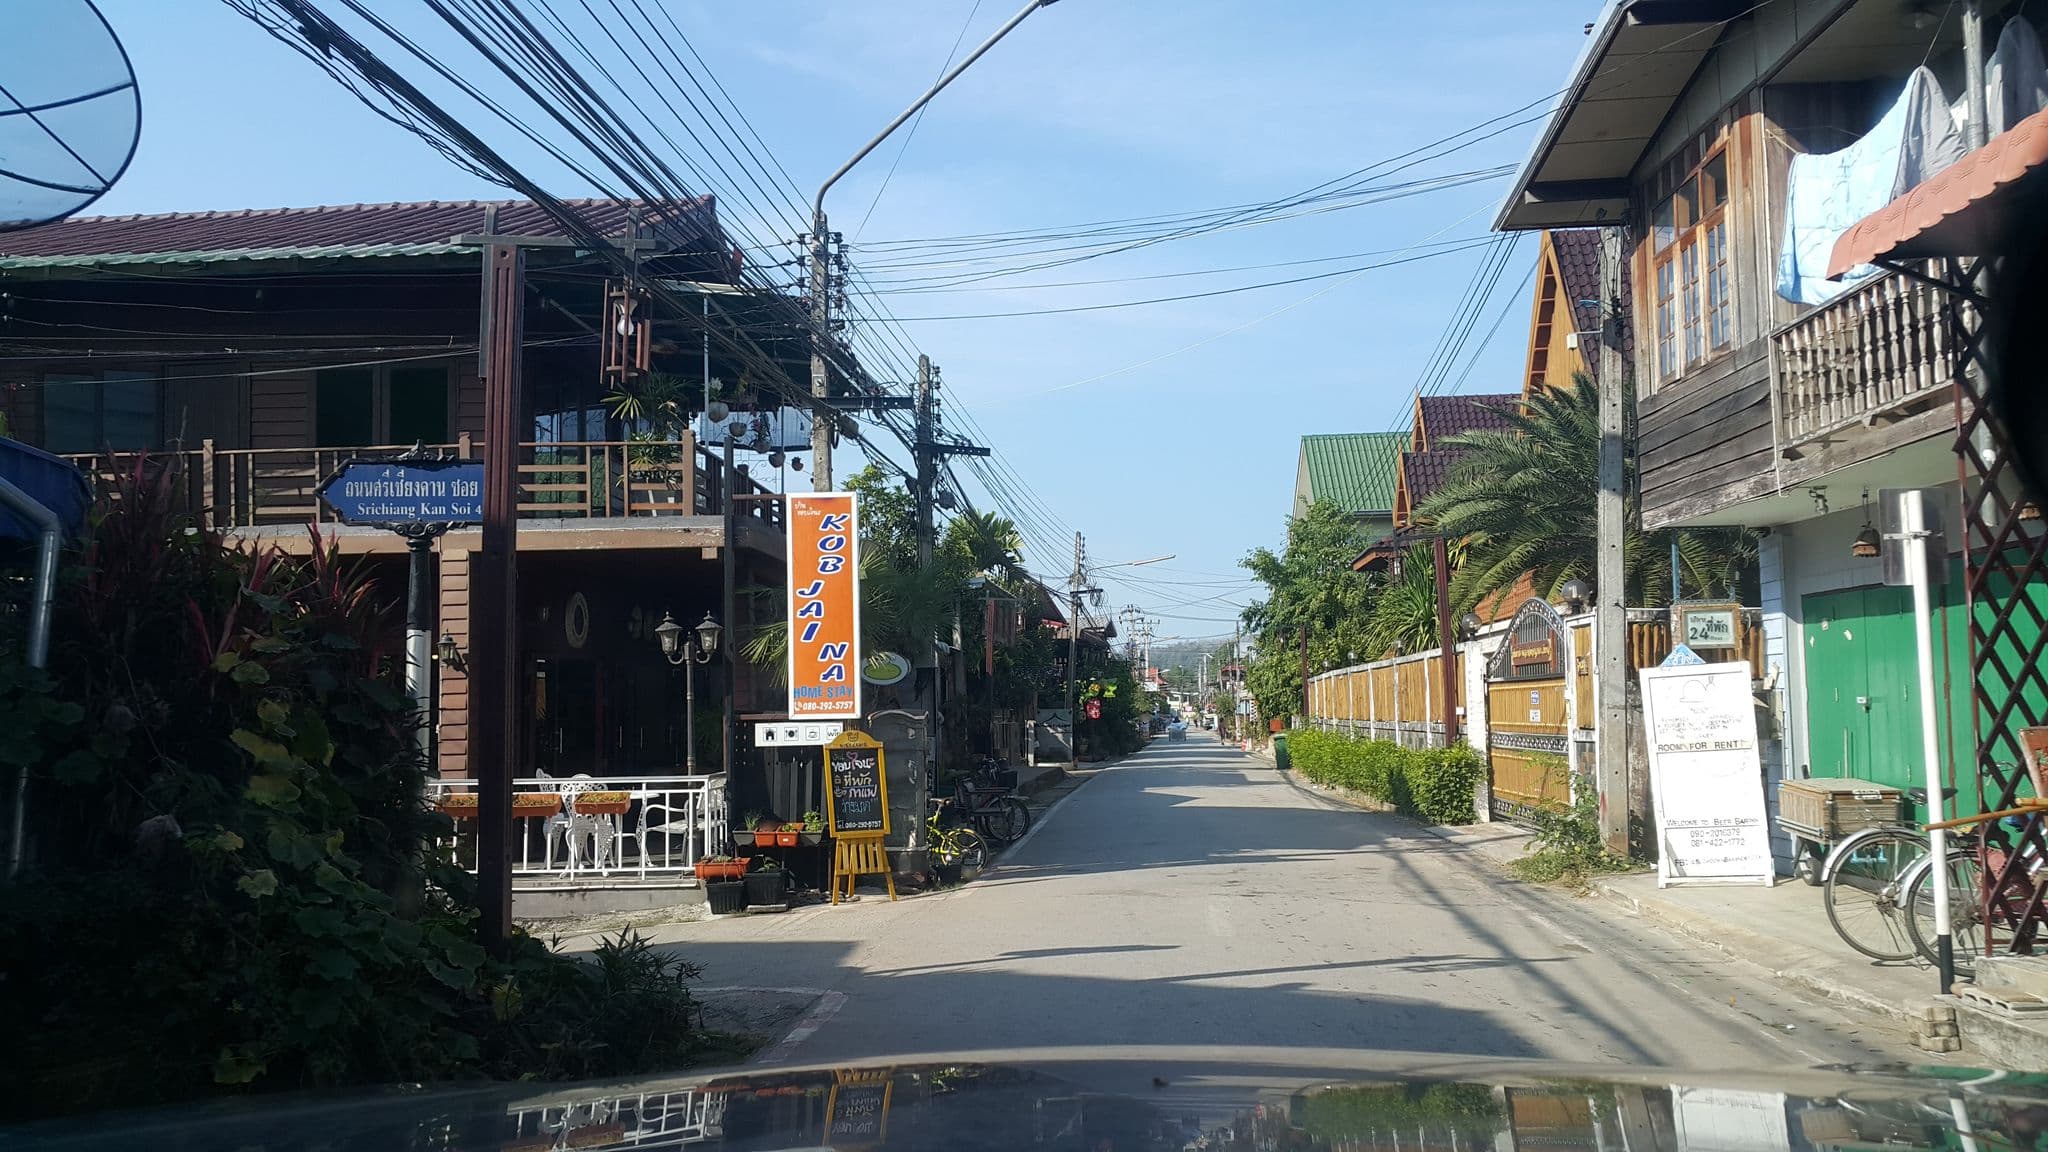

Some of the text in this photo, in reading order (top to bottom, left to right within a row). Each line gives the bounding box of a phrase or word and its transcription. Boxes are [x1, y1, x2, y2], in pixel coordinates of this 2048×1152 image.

[451, 480, 479, 498] ซอย
[357, 502, 483, 518] Srichiang Kan Soi 4
[797, 513, 849, 682] KOB JAI NA
[1705, 615, 1729, 633] ที่พัก
[1689, 626, 1709, 641] 24
[794, 685, 853, 699] HOME STAY
[802, 701, 854, 711] 080-292-5757
[1689, 741, 1708, 750] FOR
[843, 771, 873, 786] ที่พัก
[848, 784, 878, 798] กาแฟ
